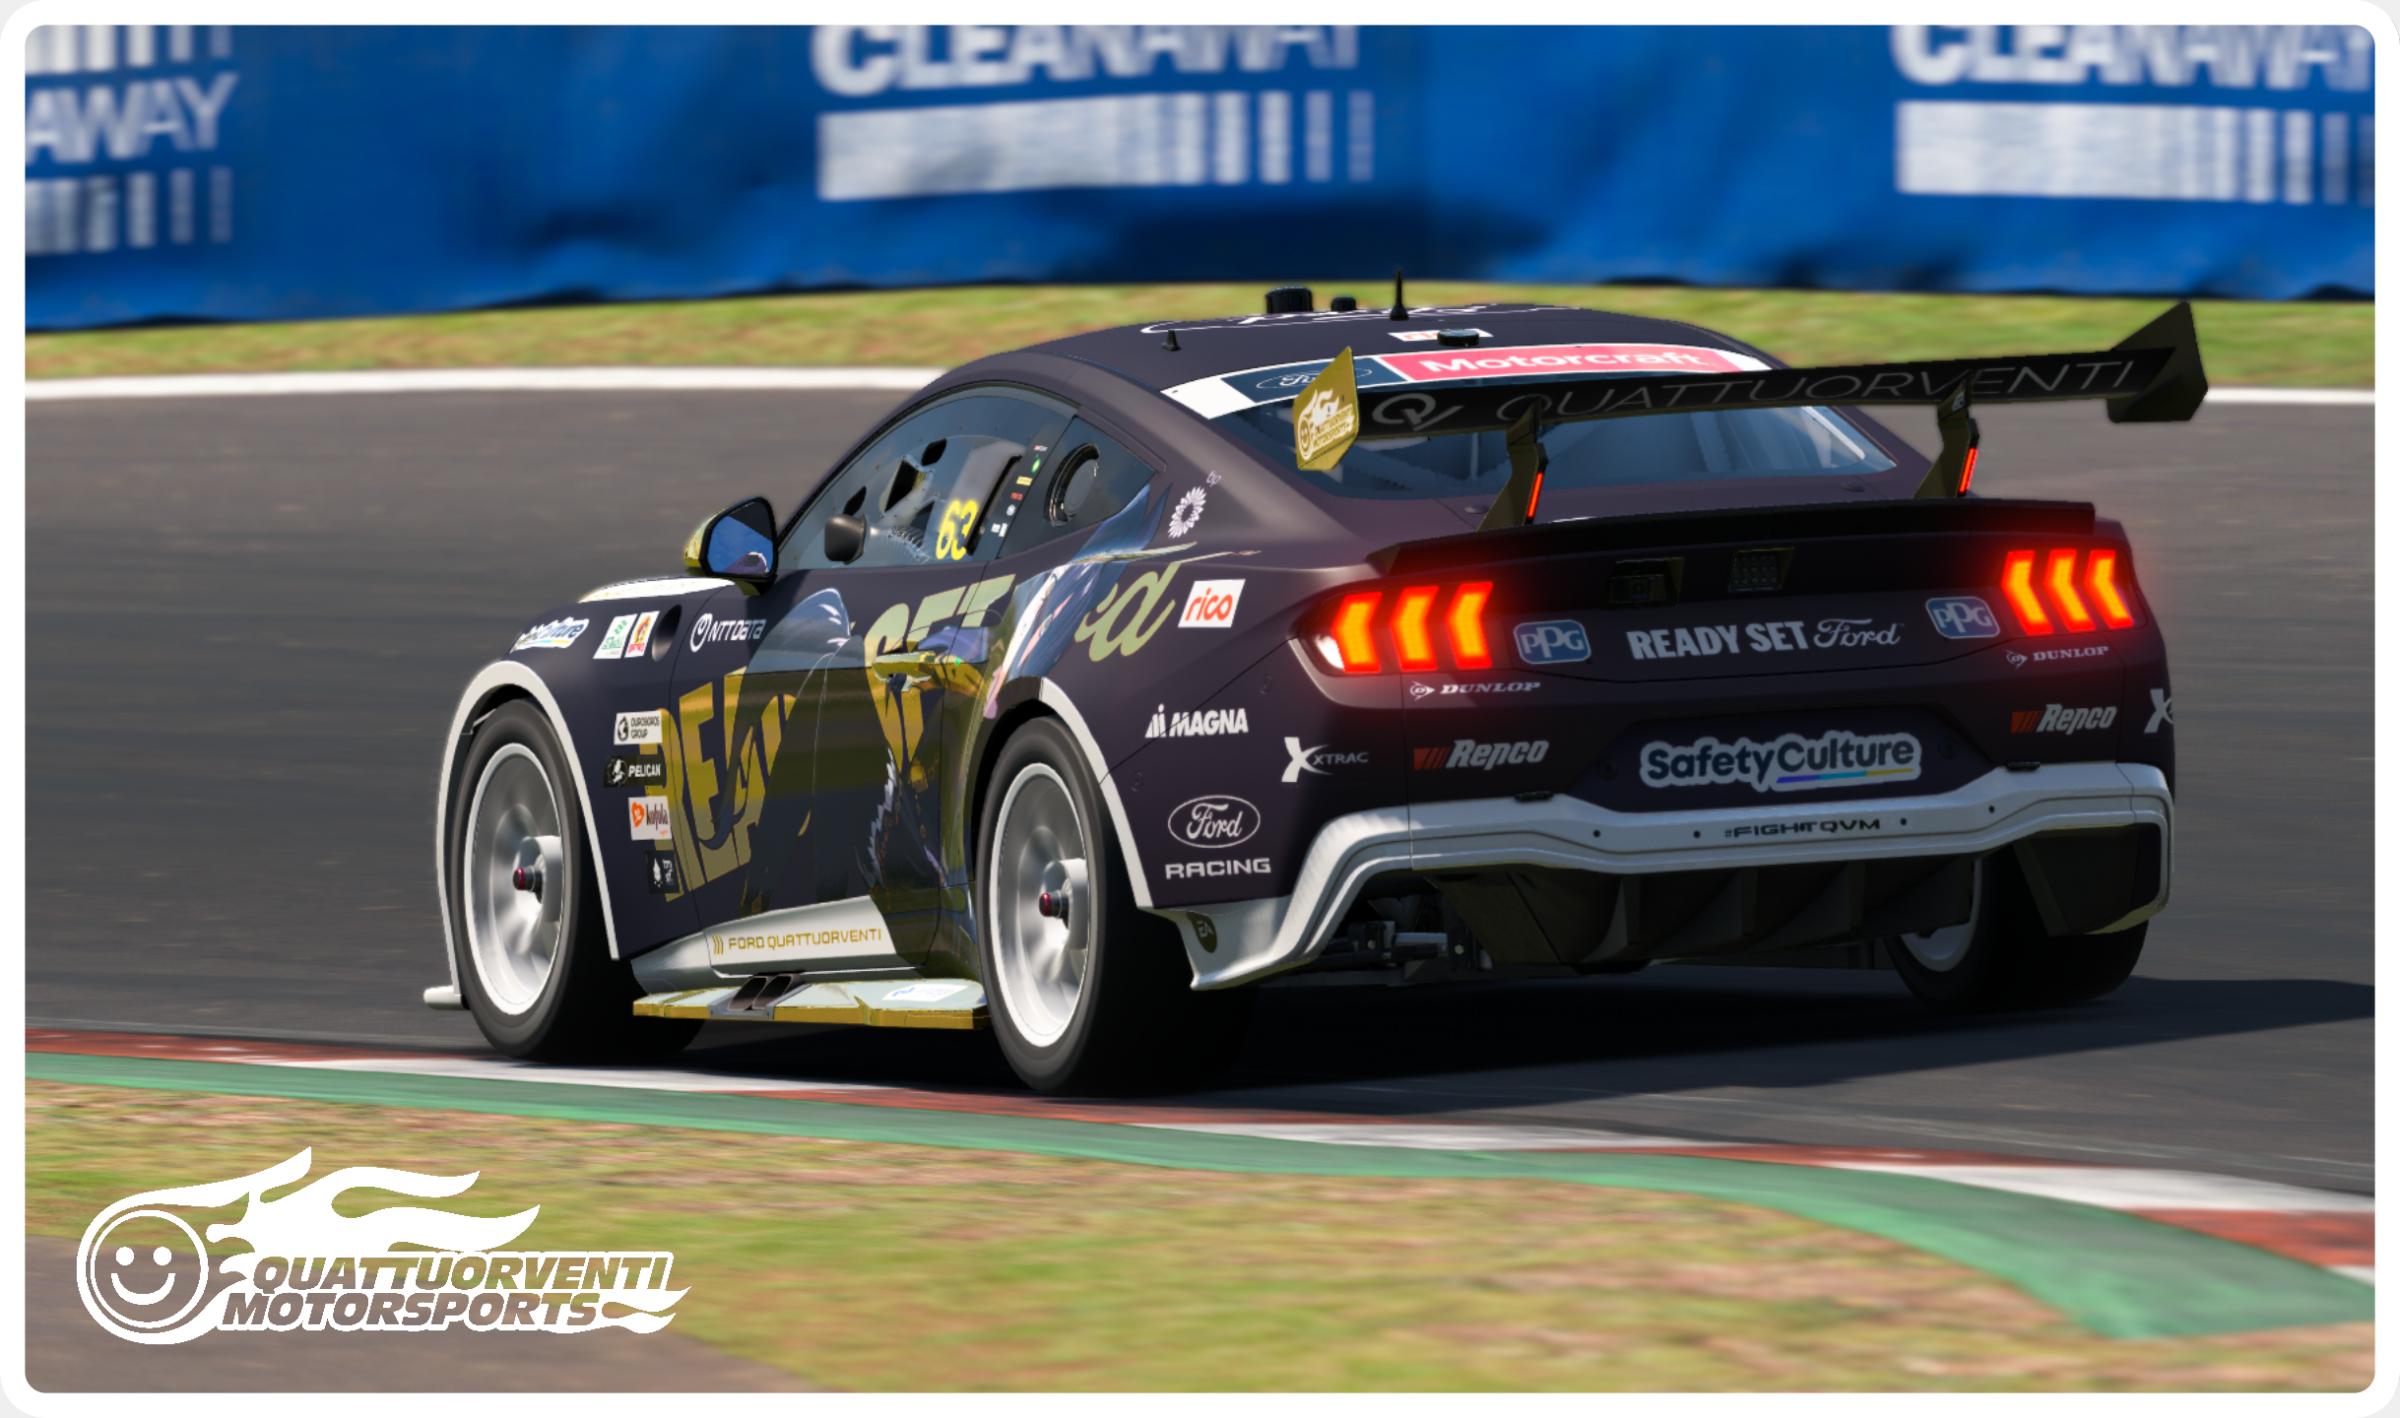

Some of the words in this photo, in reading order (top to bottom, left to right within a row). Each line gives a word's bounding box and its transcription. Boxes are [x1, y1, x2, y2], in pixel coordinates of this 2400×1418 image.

[1420, 349, 1709, 374] Motorcraft
[1496, 361, 2134, 423] QUATTUORVENTI
[935, 499, 979, 560] 63
[1186, 587, 1233, 621] rico
[1933, 602, 1993, 633] PPG
[1520, 627, 1584, 659] PPG
[1626, 624, 1740, 660] READY
[1745, 620, 1810, 653] SET
[1813, 618, 1902, 649] Ford
[2033, 646, 2110, 662] DUNLOP
[1440, 681, 1541, 695] DUNLOP
[1169, 707, 1249, 738] MAGNA
[2036, 703, 2118, 735] Repco
[628, 763, 661, 778] PELICAN
[1312, 752, 1369, 766] XTRAC
[1446, 739, 1550, 771] Repco
[1648, 737, 1914, 784] SafetyCulture
[1186, 802, 1243, 840] Ford
[1165, 857, 1272, 880] RACING
[728, 936, 765, 951] FORD
[767, 928, 882, 951] QUATTUORVENTI
